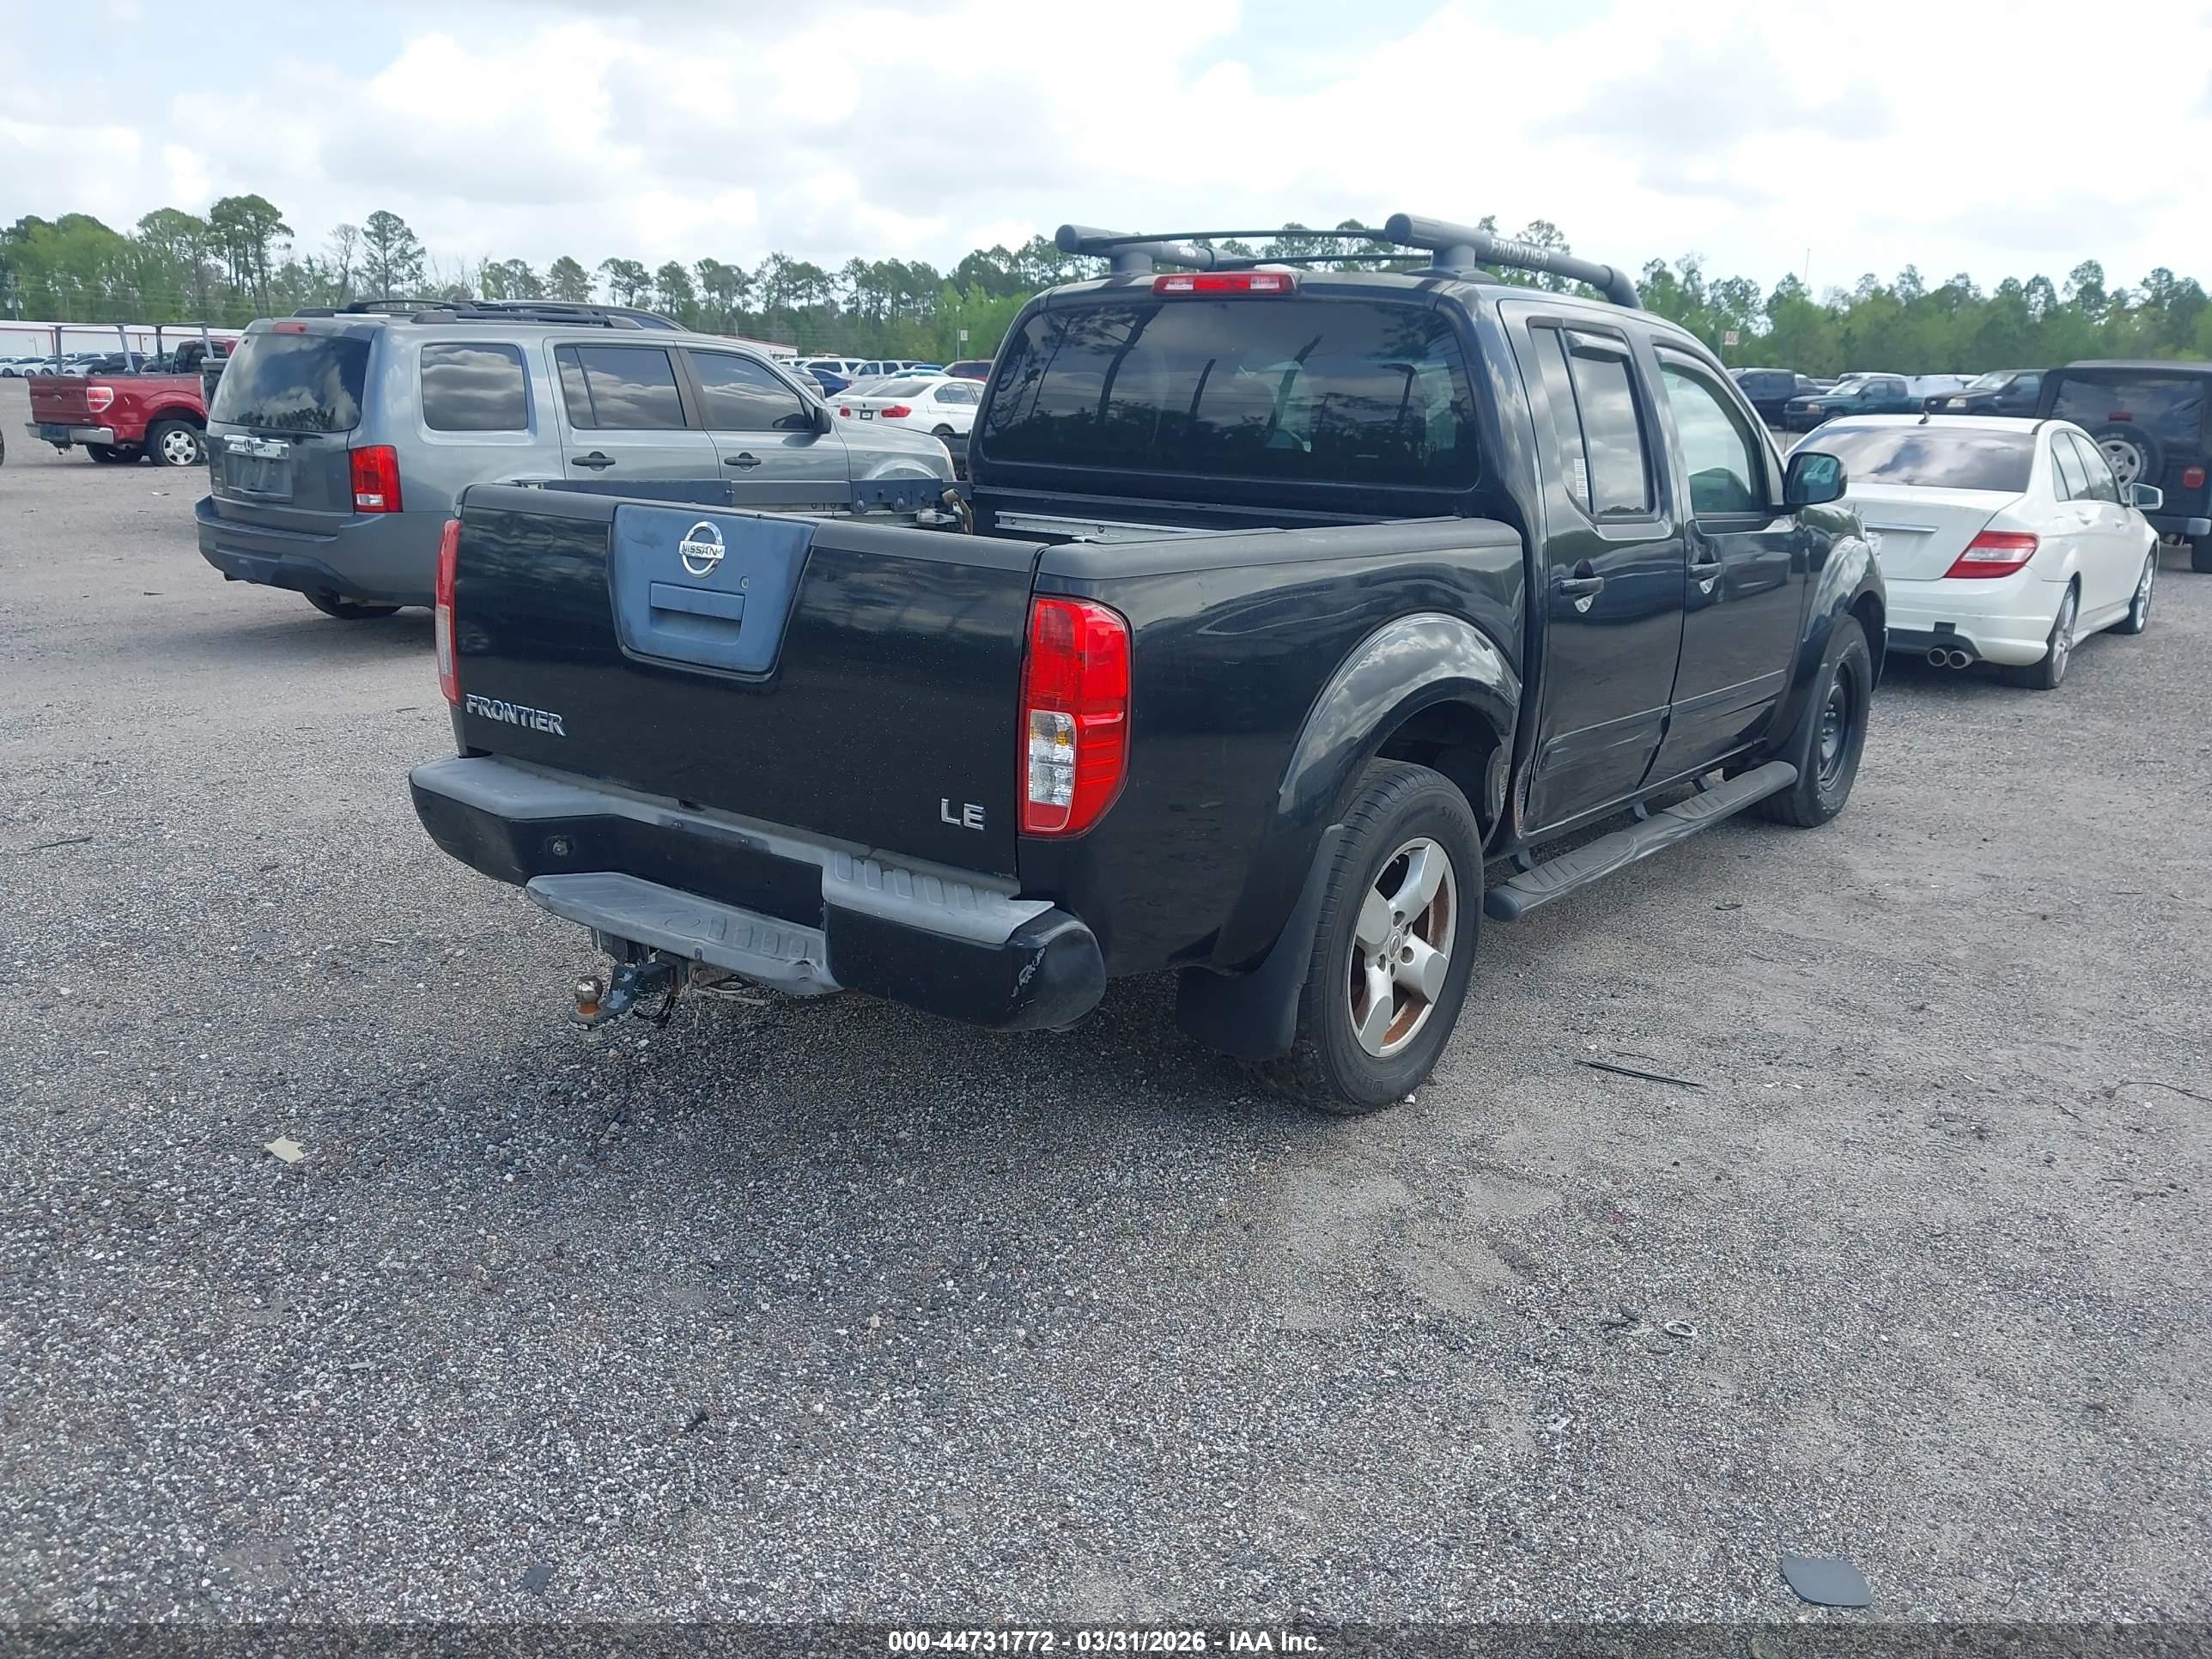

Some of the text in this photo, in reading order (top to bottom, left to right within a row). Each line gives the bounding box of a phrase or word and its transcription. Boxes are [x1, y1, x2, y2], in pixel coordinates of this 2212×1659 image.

[1489, 237, 1549, 266] FRONTIER
[682, 542, 718, 556] NISSAN
[465, 693, 567, 737] FRONTIER
[941, 798, 985, 831] LE
